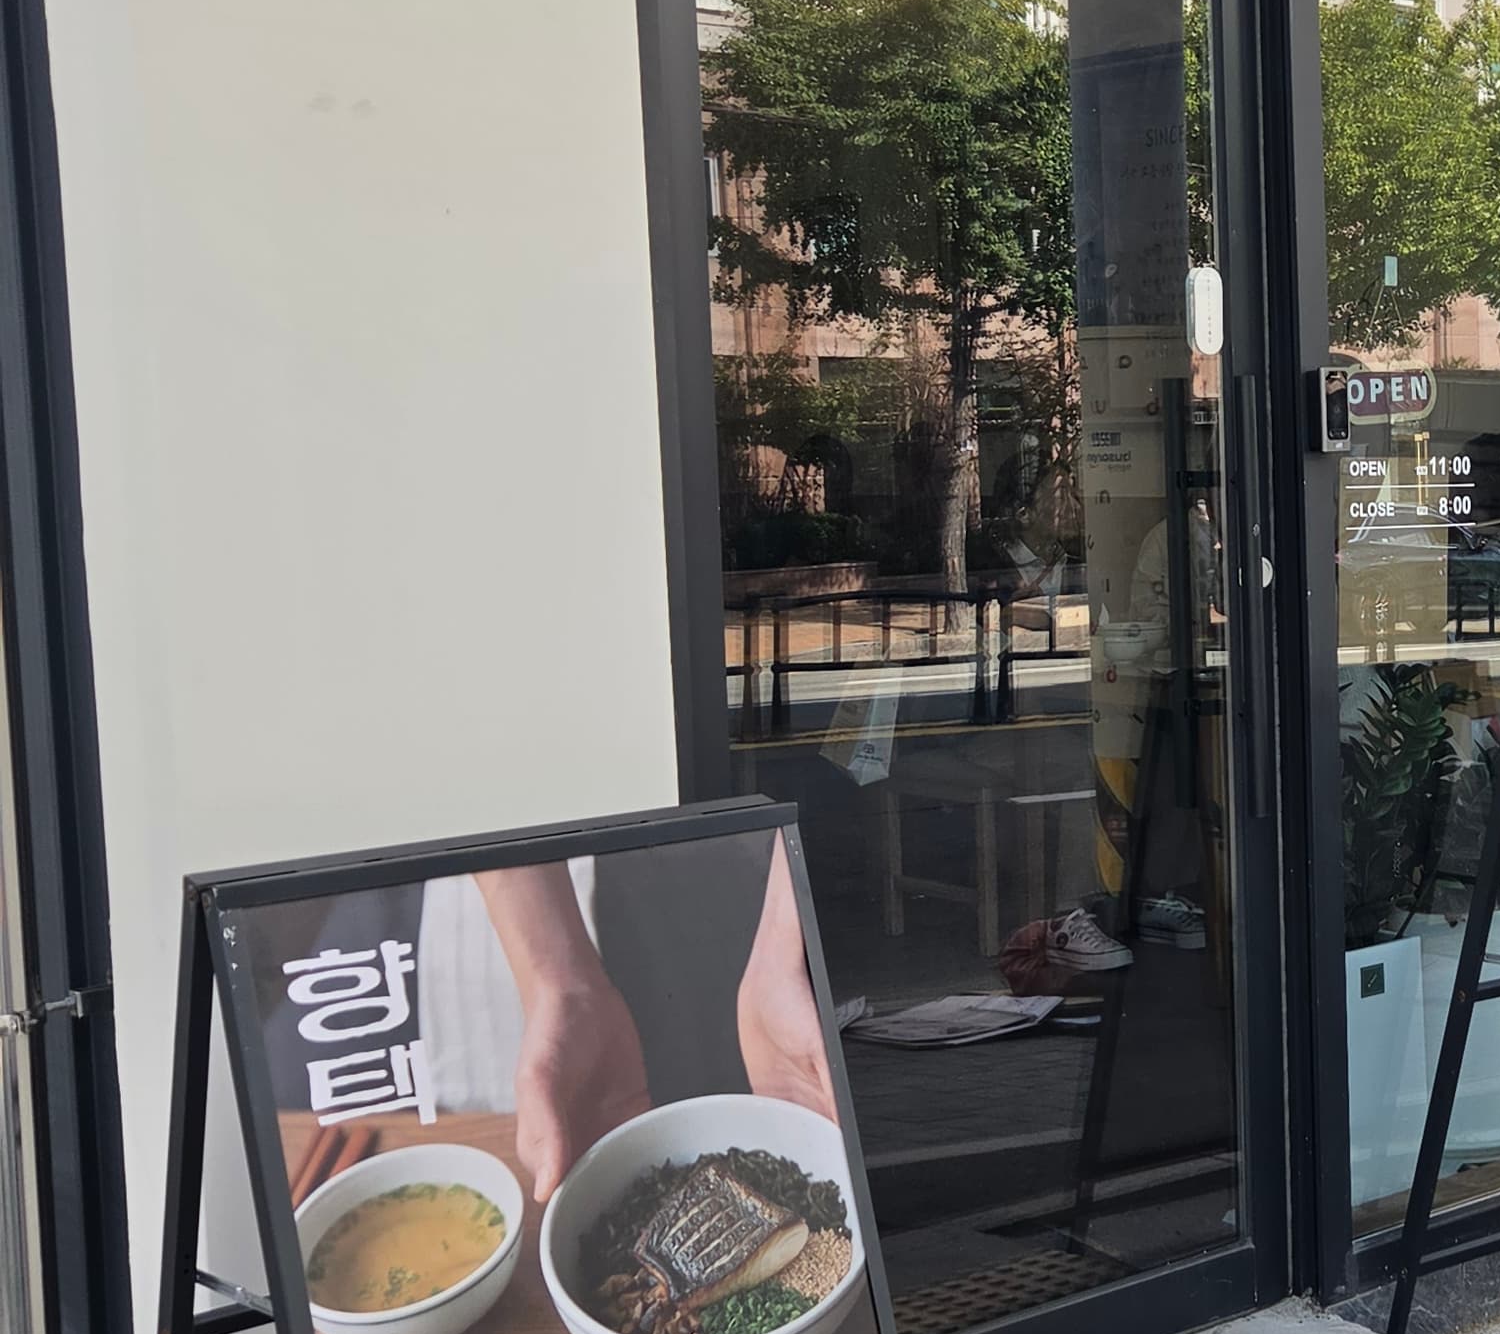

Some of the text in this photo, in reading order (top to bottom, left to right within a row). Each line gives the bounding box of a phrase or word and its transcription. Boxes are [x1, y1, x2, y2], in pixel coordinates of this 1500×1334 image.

[1348, 376, 1428, 405] OPEN
[1349, 460, 1387, 477] OPEN
[1429, 456, 1472, 476] 11:00
[1349, 502, 1395, 518] CLOSE
[1438, 496, 1472, 516] 8:00
[282, 940, 437, 1126] 향택
